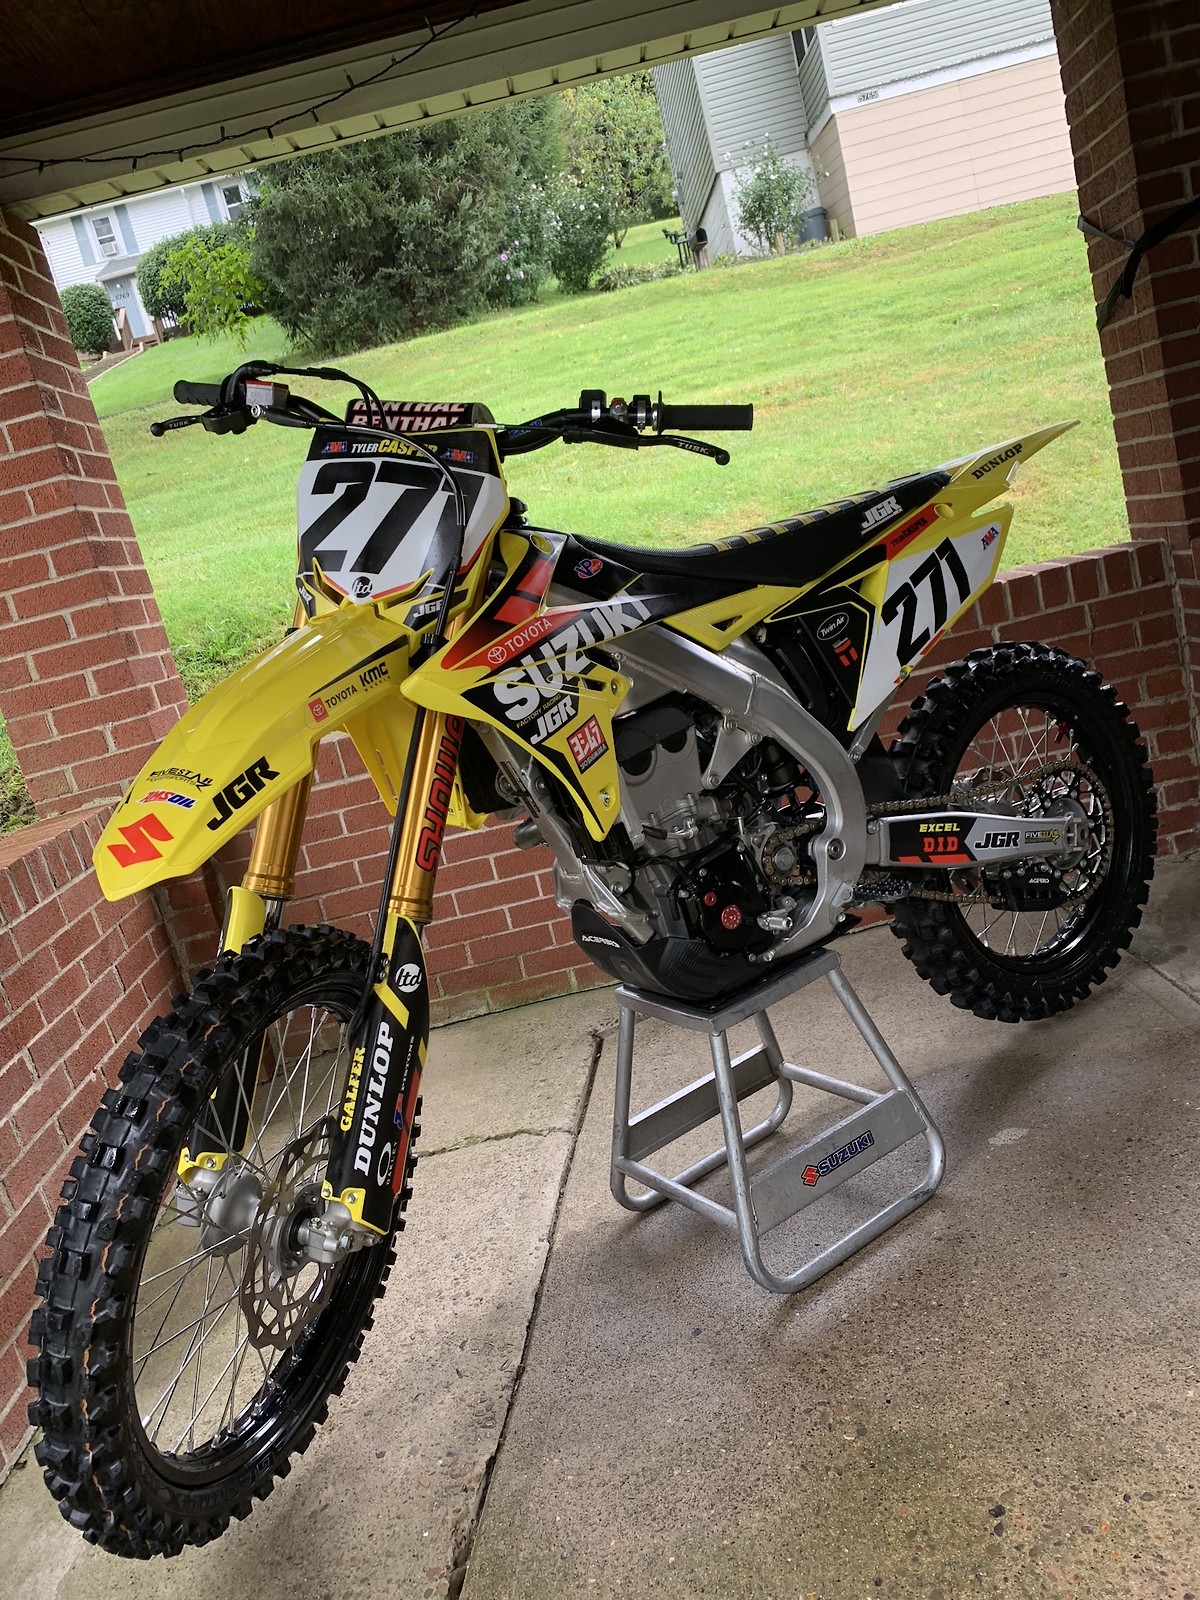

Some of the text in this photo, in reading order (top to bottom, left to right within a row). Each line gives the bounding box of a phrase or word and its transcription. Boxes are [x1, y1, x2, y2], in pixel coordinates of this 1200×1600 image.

[677, 440, 709, 455] TUSK
[971, 442, 1023, 480] DUNLOP
[861, 495, 902, 532] JGR
[881, 536, 971, 668] 271
[505, 618, 552, 652] TOYOTA
[493, 588, 652, 721] SUZUKI
[325, 684, 358, 709] TOYOTA
[516, 708, 541, 729] FACTORY
[530, 695, 576, 745] JGR
[142, 790, 197, 809] AMSOIL
[206, 755, 281, 831] JGR
[919, 822, 960, 833] EXCEL
[974, 831, 1020, 849] JGR
[340, 1046, 366, 1132] GALFER
[354, 1021, 394, 1176] DUNLOP
[818, 1131, 873, 1175] SUZUKI
